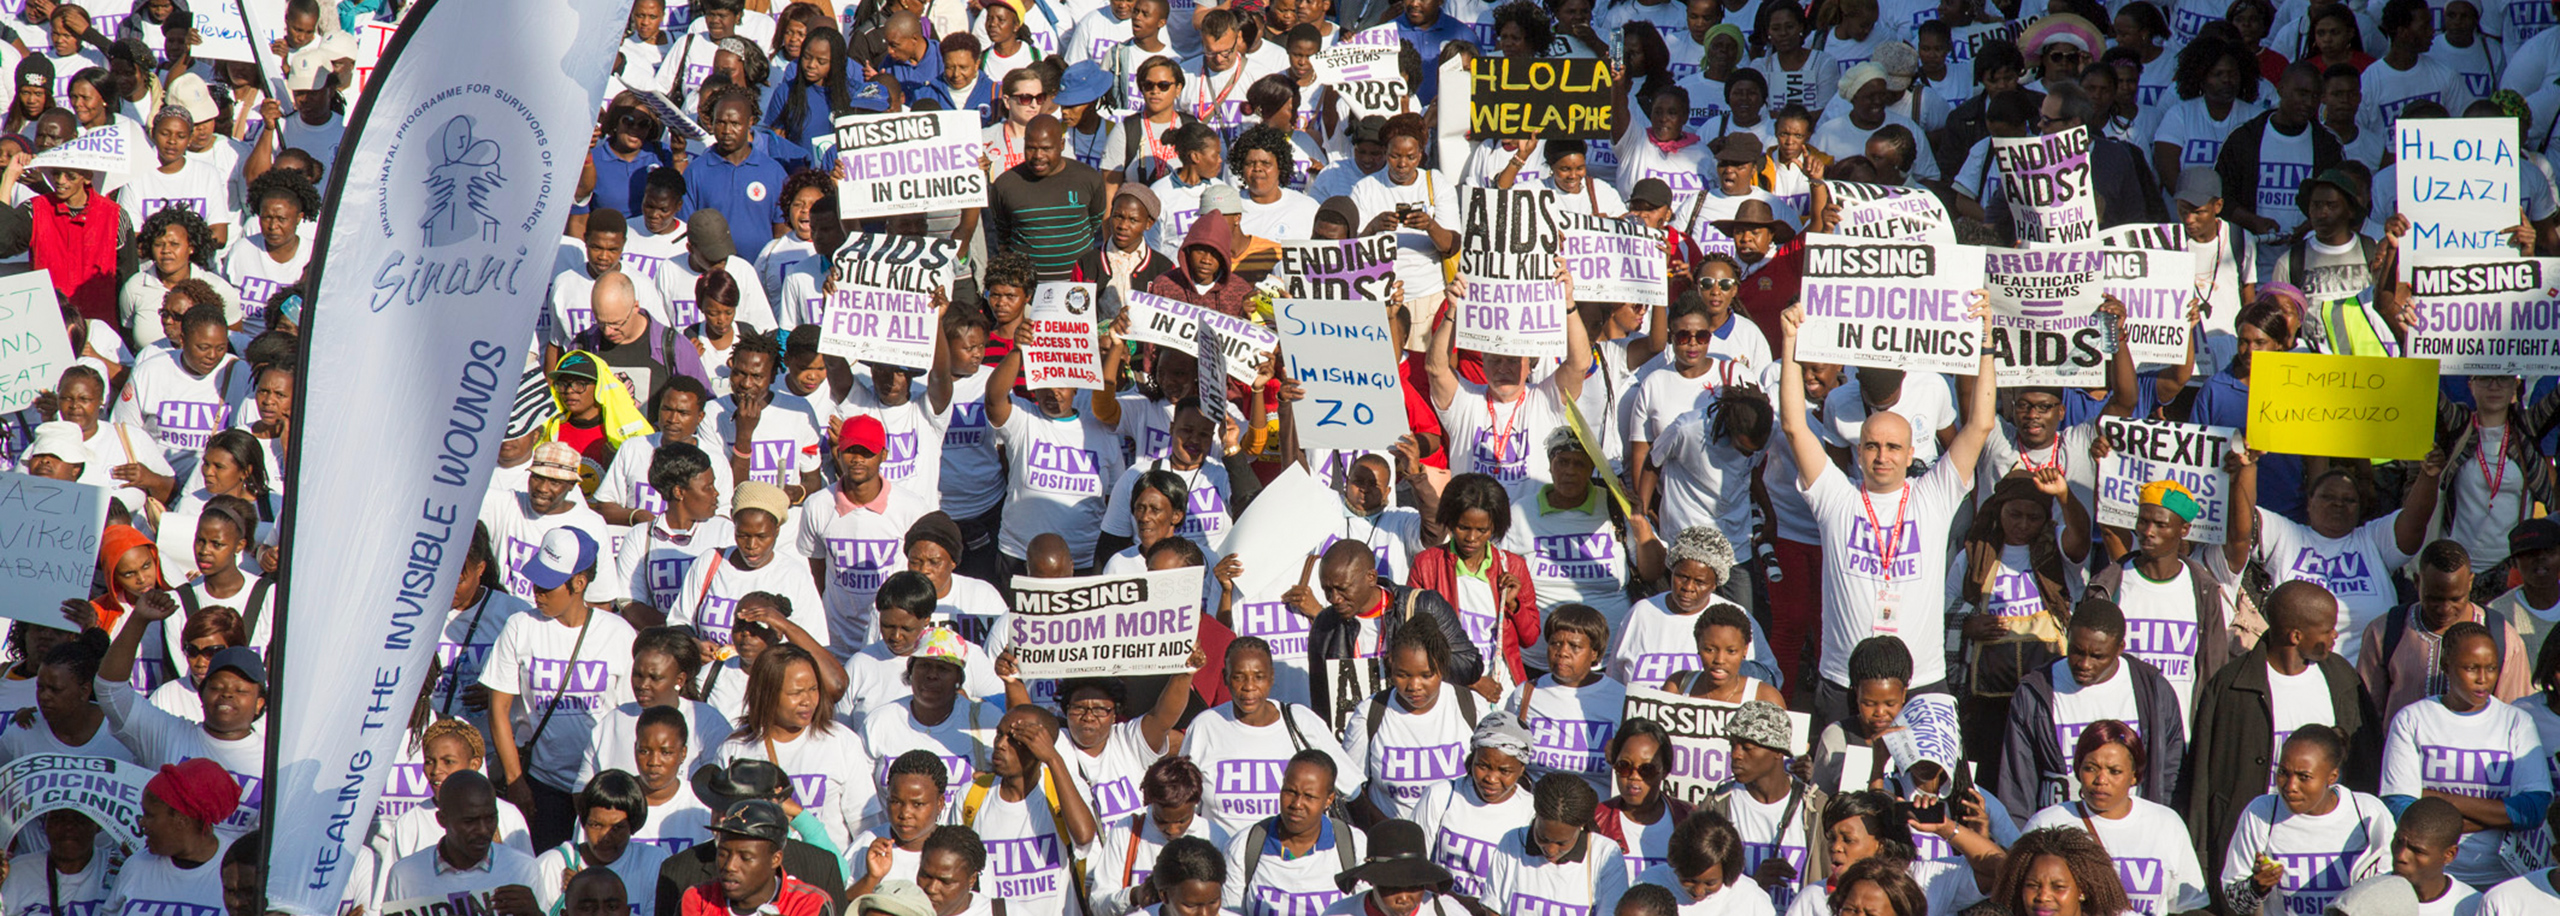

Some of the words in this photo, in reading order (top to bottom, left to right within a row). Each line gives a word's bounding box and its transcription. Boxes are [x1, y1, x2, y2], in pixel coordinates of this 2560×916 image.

[1326, 53, 1381, 69] SYSTEMS
[1471, 58, 1613, 93] HLOLA
[466, 82, 491, 95] FOR
[395, 85, 463, 141] PROGRAMME
[494, 88, 548, 147] SURVIVORS
[1470, 101, 1612, 134] WELAPHE
[839, 115, 935, 149] MISSING
[541, 150, 553, 168] OF
[842, 142, 980, 182] MEDICINES
[1994, 128, 2090, 172] ENDING
[2402, 127, 2514, 168] HLOLA
[379, 143, 400, 239] KWAZULU-NATAL
[871, 180, 892, 203] IN
[899, 173, 982, 201] CLINICS
[2004, 162, 2090, 208] AIDS?
[2258, 189, 2300, 206] POSIT
[2413, 176, 2508, 203] UZAZI
[520, 171, 552, 234] VIOLENCE
[1853, 208, 1883, 226] NOT
[2021, 208, 2044, 228] NOT
[2049, 205, 2084, 227] EVEN
[1464, 187, 1559, 254] AIDS
[1560, 208, 1609, 234] STILL
[2016, 219, 2094, 244] HALFWAY
[840, 232, 957, 269] AIDS
[1282, 234, 1397, 275] ENDING
[1462, 249, 1509, 280] STILL
[1704, 243, 1735, 257] POSI
[1808, 247, 1929, 276] MISSING
[1984, 249, 2104, 274] BROKEN
[370, 244, 528, 313] Sinani
[833, 256, 879, 287] STILL
[886, 264, 941, 294] KILLS
[1568, 257, 1611, 280] FOR
[1620, 257, 1661, 281] ALL
[1988, 271, 2095, 288] HEALTHCARE
[2416, 263, 2533, 294] MISSING
[243, 278, 290, 302] HI
[829, 290, 936, 314] TREATMENT
[1466, 281, 1565, 304] REATMENT
[1807, 283, 1980, 323] MEDICINES
[2003, 284, 2081, 299] SYSTEMS
[832, 312, 878, 337] FOR
[887, 315, 930, 341] ALL
[1045, 321, 1089, 334] DEMAND
[1130, 290, 1276, 344] MEDICINES
[1150, 312, 1175, 334] IN
[1284, 303, 1388, 342] SIDINGA
[1465, 304, 1510, 331] FOR
[1519, 304, 1561, 331] ALL
[2413, 299, 2502, 337] $500M
[1073, 338, 1089, 349] TO
[1837, 323, 1863, 349] IN
[1871, 325, 1975, 357] CLINICS
[1993, 327, 2104, 368] AIDS
[2414, 337, 2458, 355] FROM
[2460, 337, 2485, 355] USA
[2488, 338, 2505, 355] TO
[2506, 338, 2548, 356] FIGHT
[1028, 350, 1093, 364] TREATMENT
[1043, 366, 1065, 378] FOR
[1068, 367, 1087, 379] ALL
[1291, 355, 1395, 389] IMISHNGU
[2280, 364, 2385, 390] IMPILO
[162, 404, 231, 428] HIV
[1315, 398, 1374, 427] ZO
[2259, 400, 2400, 423] KUNENZUZO
[161, 431, 213, 448] POSITI
[887, 432, 916, 461] IV
[2105, 421, 2226, 469] BREXIT
[754, 441, 793, 470] IV
[1030, 444, 1096, 473] HIV
[879, 461, 916, 481] SITIVE
[1029, 471, 1095, 493] POSITIVE
[2119, 455, 2155, 482] THE
[2164, 463, 2217, 497] AIDS
[830, 541, 897, 569] HIV
[1540, 535, 1609, 560] HIV
[652, 560, 691, 588] HI
[1537, 562, 1612, 578] POSITIVE
[1016, 580, 1140, 614] MISSING
[309, 748, 372, 890] HEALING
[360, 666, 401, 736] THE
[384, 498, 457, 651] INVISIBLE
[433, 339, 506, 487] WOUNDS
[1011, 615, 1106, 648] $500M
[1115, 604, 1193, 640] MORE
[2126, 621, 2196, 652] HIV
[1013, 645, 1055, 665] FROM
[1058, 644, 1088, 663] USA
[1091, 643, 1110, 660] TO
[1111, 640, 1156, 660] FIGHT
[1158, 639, 1194, 657] AIDS
[2143, 658, 2189, 676] SITIVE
[1626, 700, 1735, 737] MISSIN
[1903, 698, 1943, 763] RESPONSE
[1930, 701, 1956, 734] THE
[1533, 720, 1611, 753] HIV
[1386, 743, 1460, 779] HIV
[1529, 749, 1605, 773] POSITIVE
[2427, 747, 2512, 782] HIV
[387, 765, 433, 796] IV
[1388, 785, 1425, 800] POSI
[1096, 778, 1141, 817] IV
[1222, 798, 1280, 815] POSITI
[988, 836, 1058, 876] HIV
[1440, 830, 1491, 878] HI
[997, 874, 1057, 899] OSITIVE
[2284, 895, 2334, 916] POSIT
